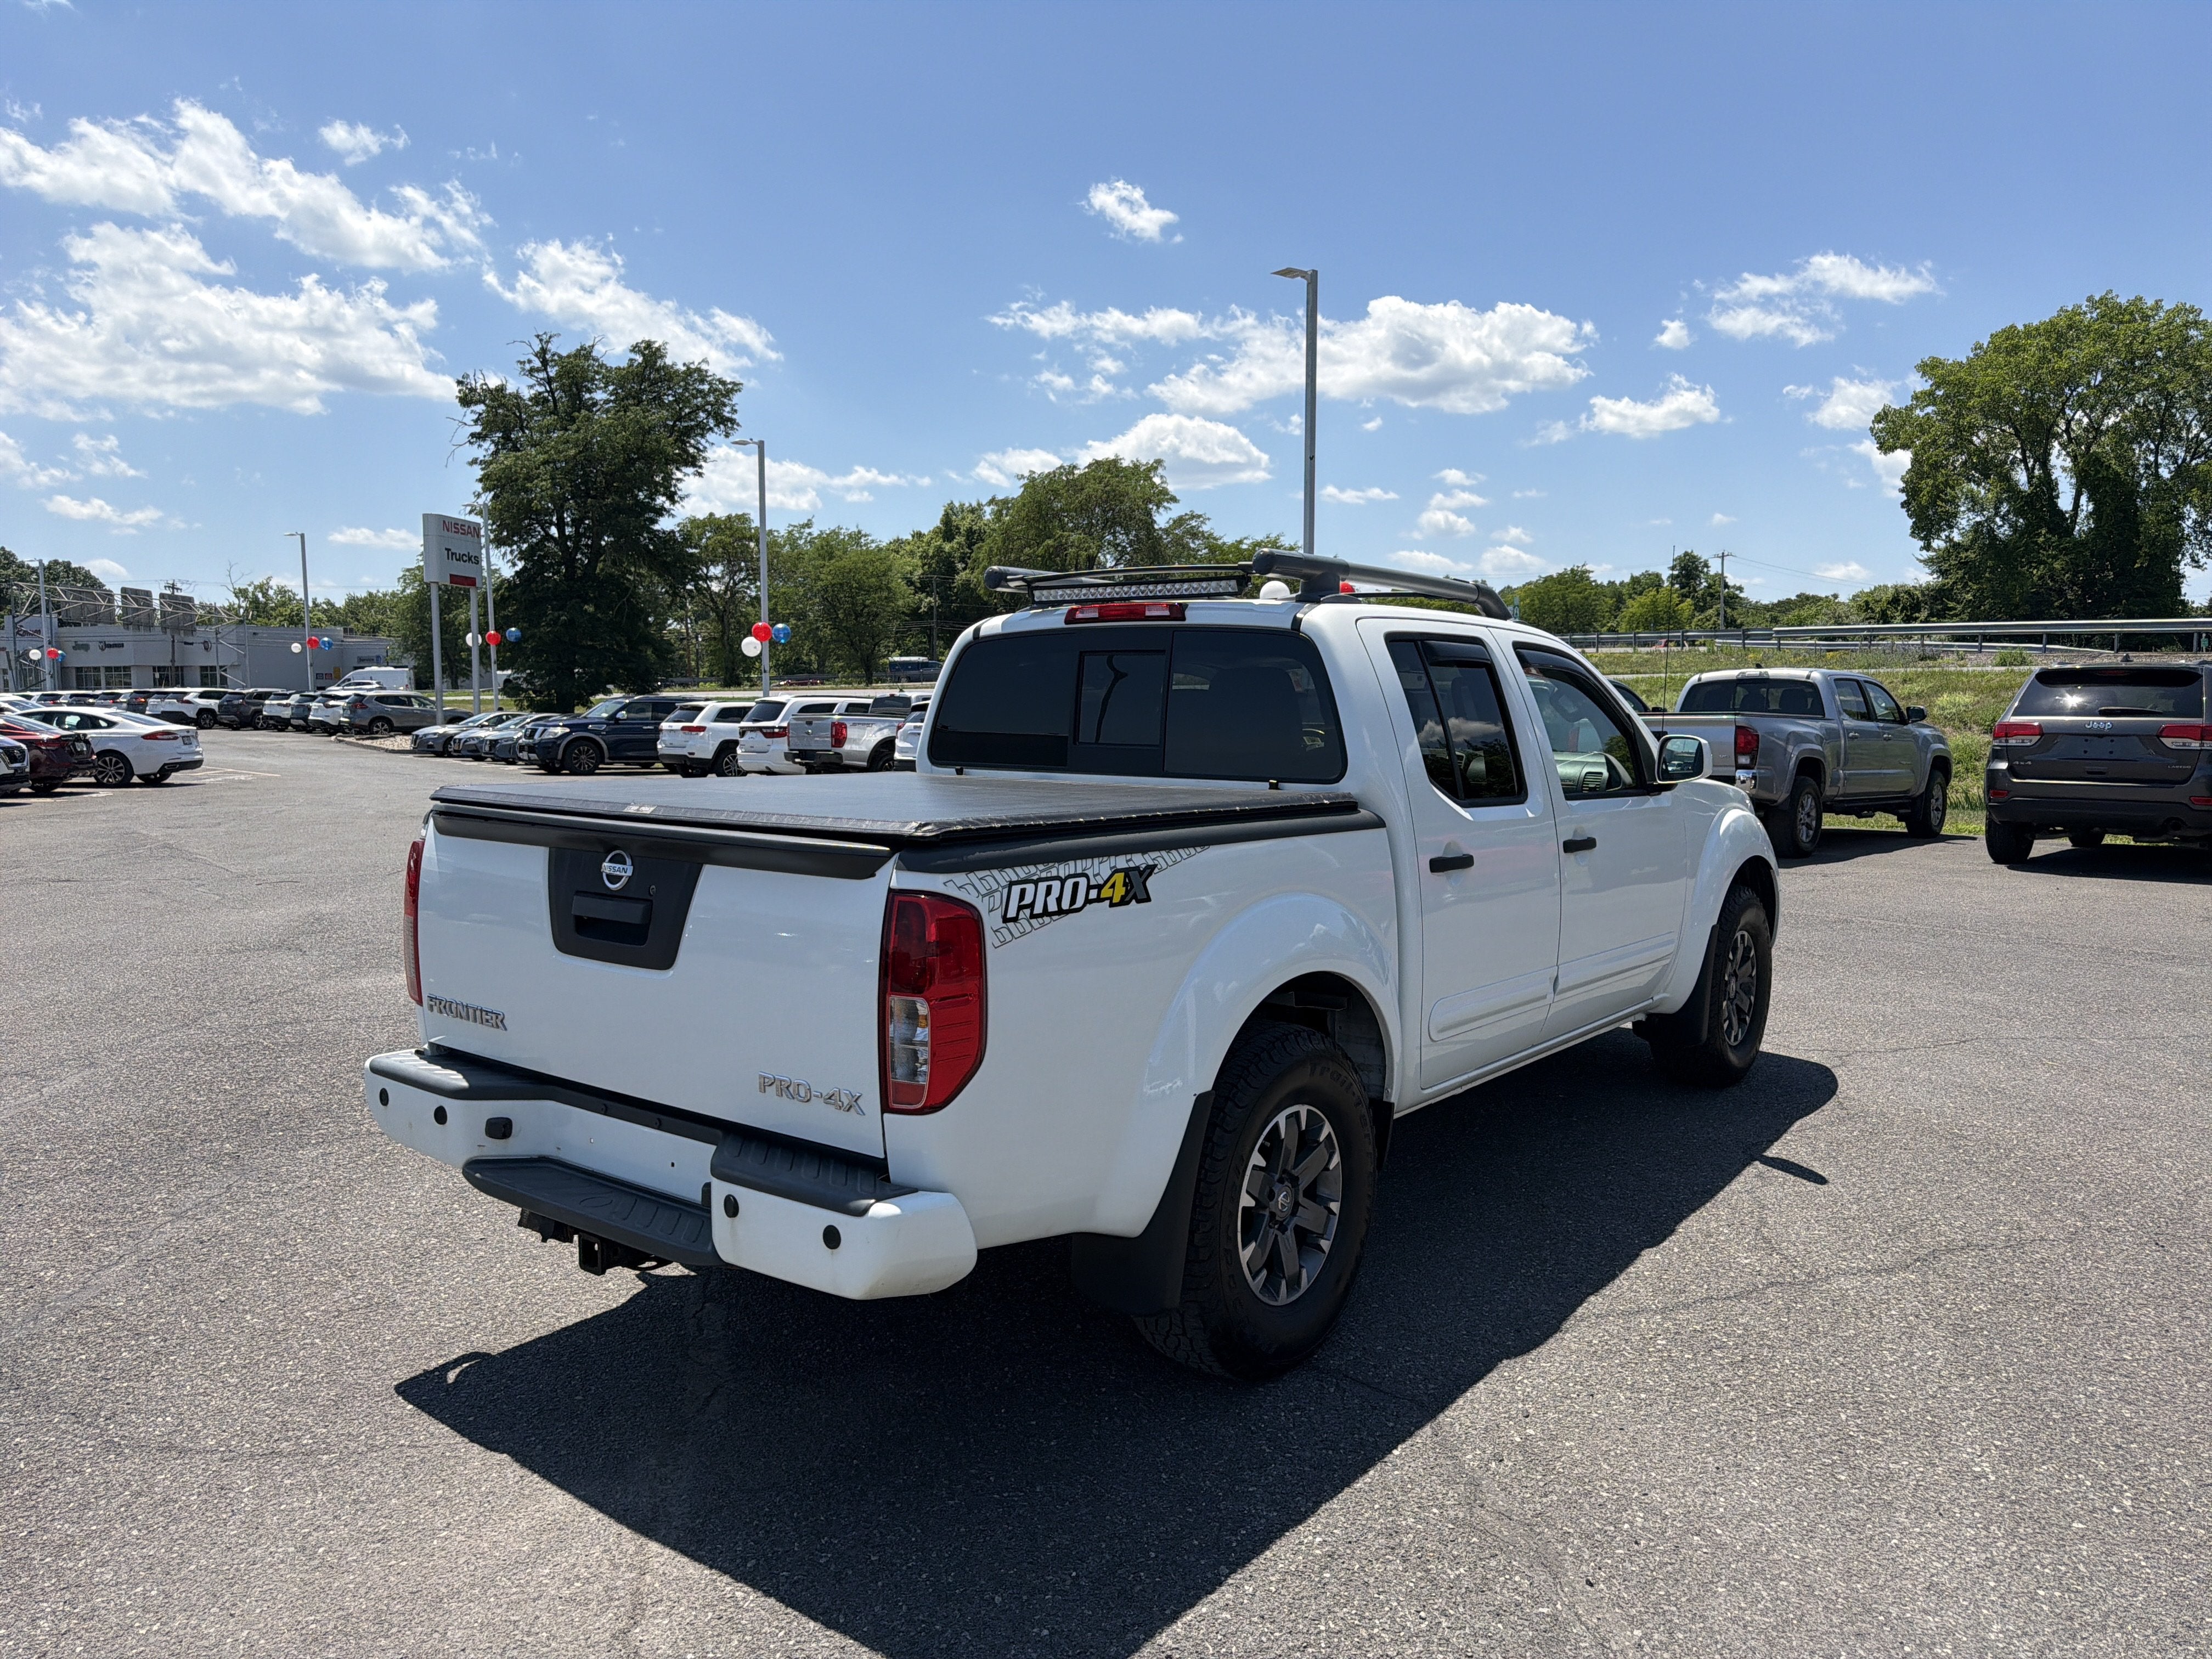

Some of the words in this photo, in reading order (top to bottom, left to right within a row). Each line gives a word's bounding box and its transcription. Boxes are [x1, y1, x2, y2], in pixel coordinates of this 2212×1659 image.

[442, 520, 480, 539] NISSAN
[445, 548, 479, 565] Trucks
[2085, 720, 2113, 730] Jeep
[603, 864, 628, 874] NISSAN
[1002, 864, 1158, 923] PRO-4X
[427, 992, 508, 1031] FRONTIER
[758, 1071, 866, 1116] PRO-4X
